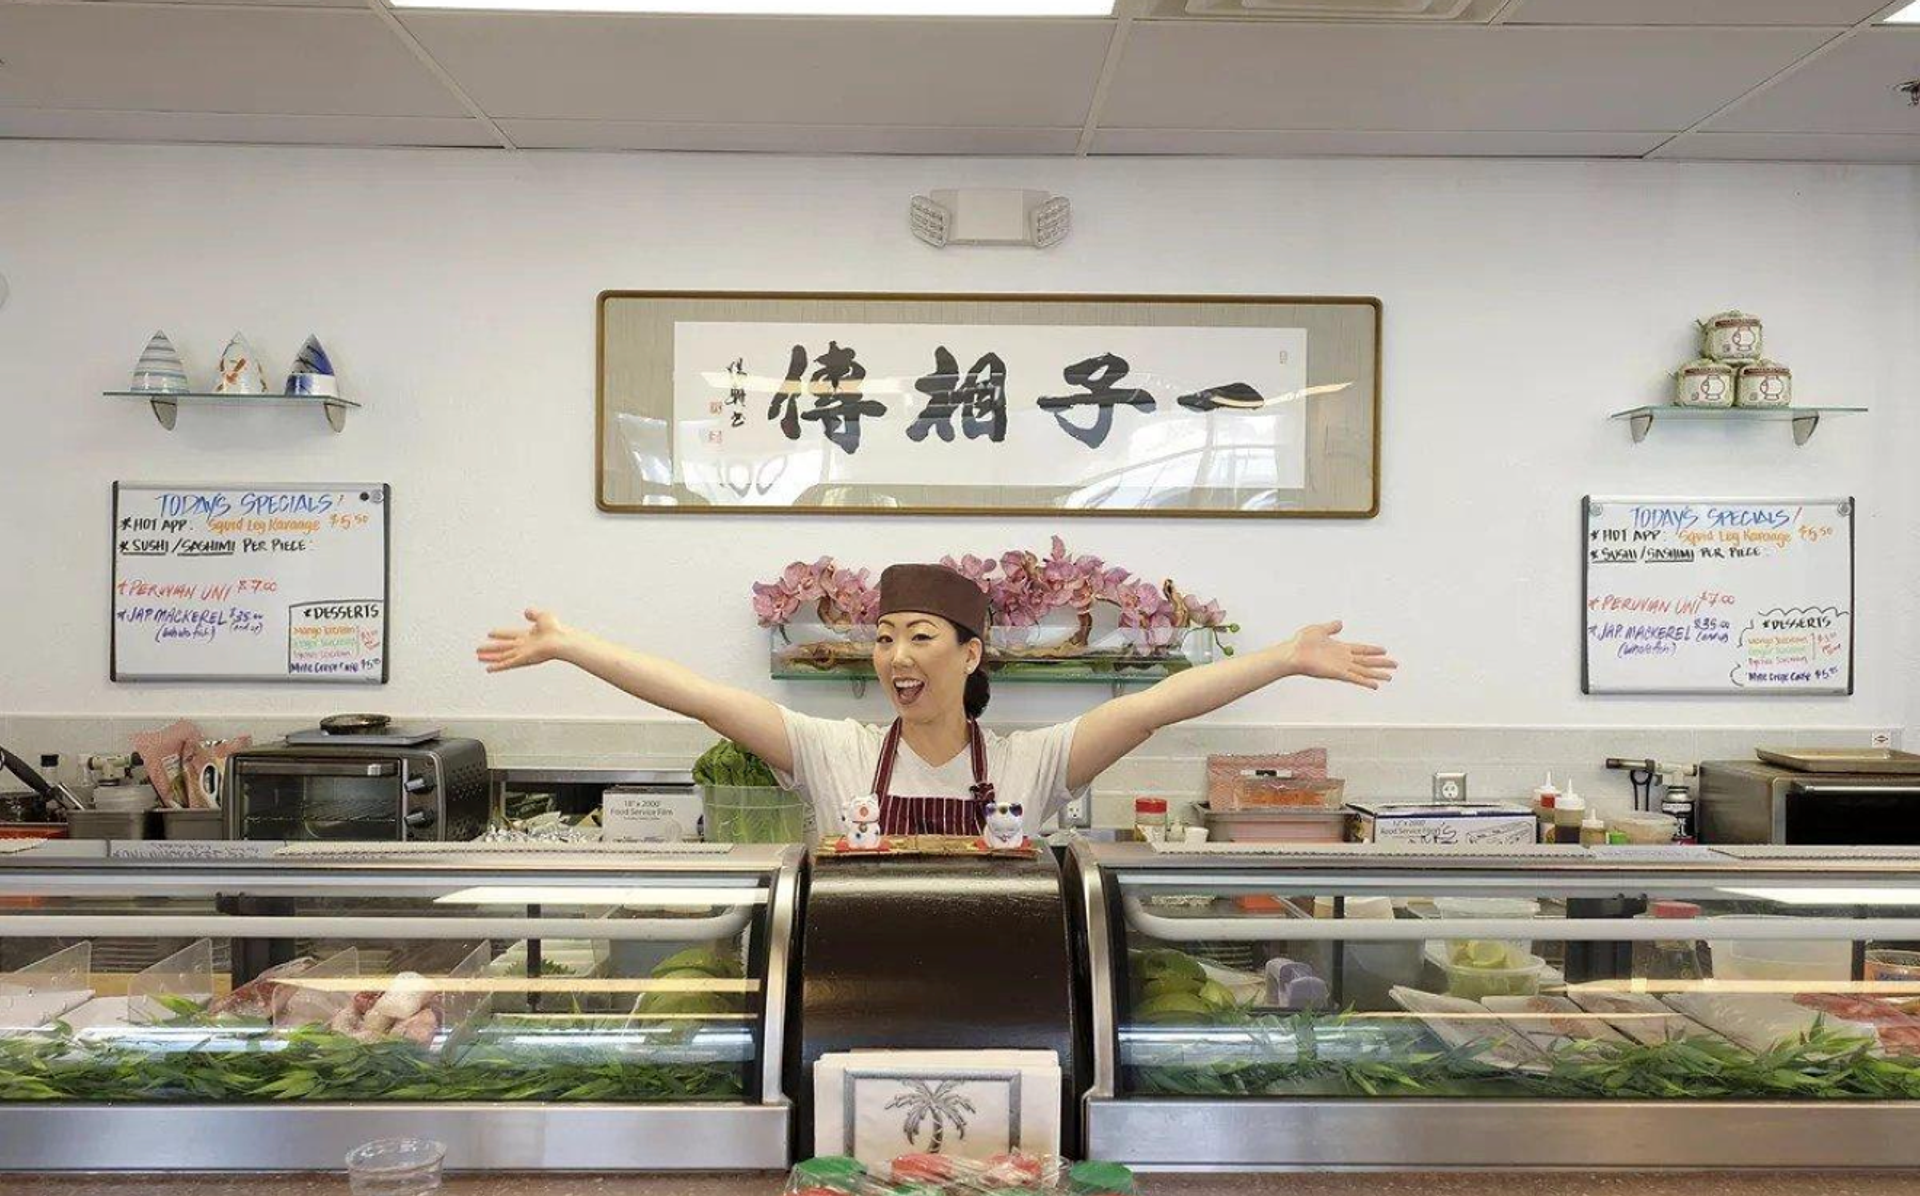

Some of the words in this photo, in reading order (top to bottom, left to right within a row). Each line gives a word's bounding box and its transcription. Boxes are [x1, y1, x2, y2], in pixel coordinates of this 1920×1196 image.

[133, 518, 157, 531] HOT
[1602, 529, 1627, 541] HOT
[132, 539, 169, 553] SUSHI
[243, 539, 267, 552] PER
[1700, 547, 1724, 559] PER
[200, 583, 232, 601] UNI
[313, 604, 379, 619] DESSERTS
[1600, 595, 1671, 614] PERUVIAN
[1675, 599, 1701, 614] UNI
[154, 605, 228, 625] MACKEREL
[1771, 616, 1832, 631] DESSERTS
[1625, 623, 1692, 641] MACKEREL
[609, 807, 629, 816] Food
[630, 807, 656, 816] Service
